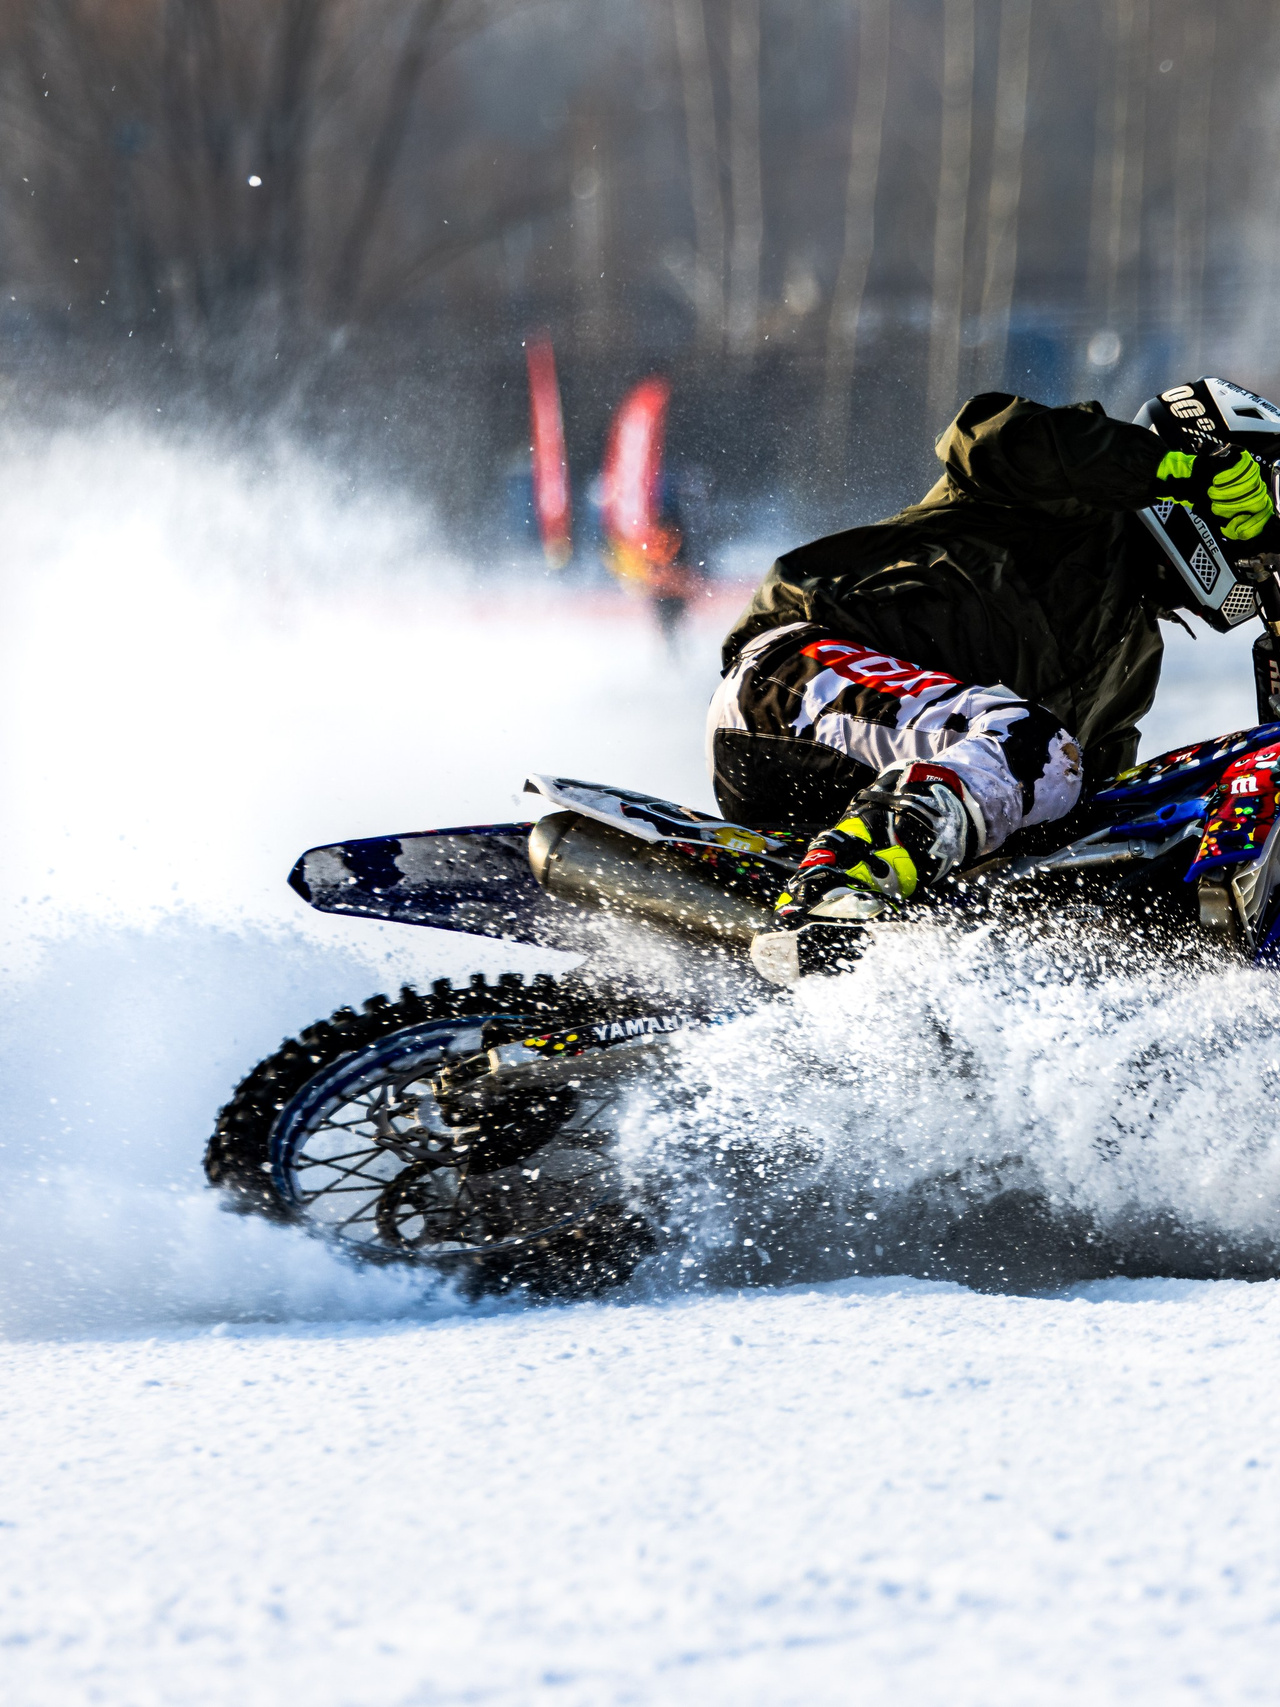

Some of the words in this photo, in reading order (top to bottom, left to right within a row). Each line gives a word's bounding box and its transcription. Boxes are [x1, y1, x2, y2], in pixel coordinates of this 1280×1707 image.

[1249, 394, 1262, 404] FOX
[1230, 775, 1259, 795] m
[593, 1014, 695, 1041] YAMAHA
